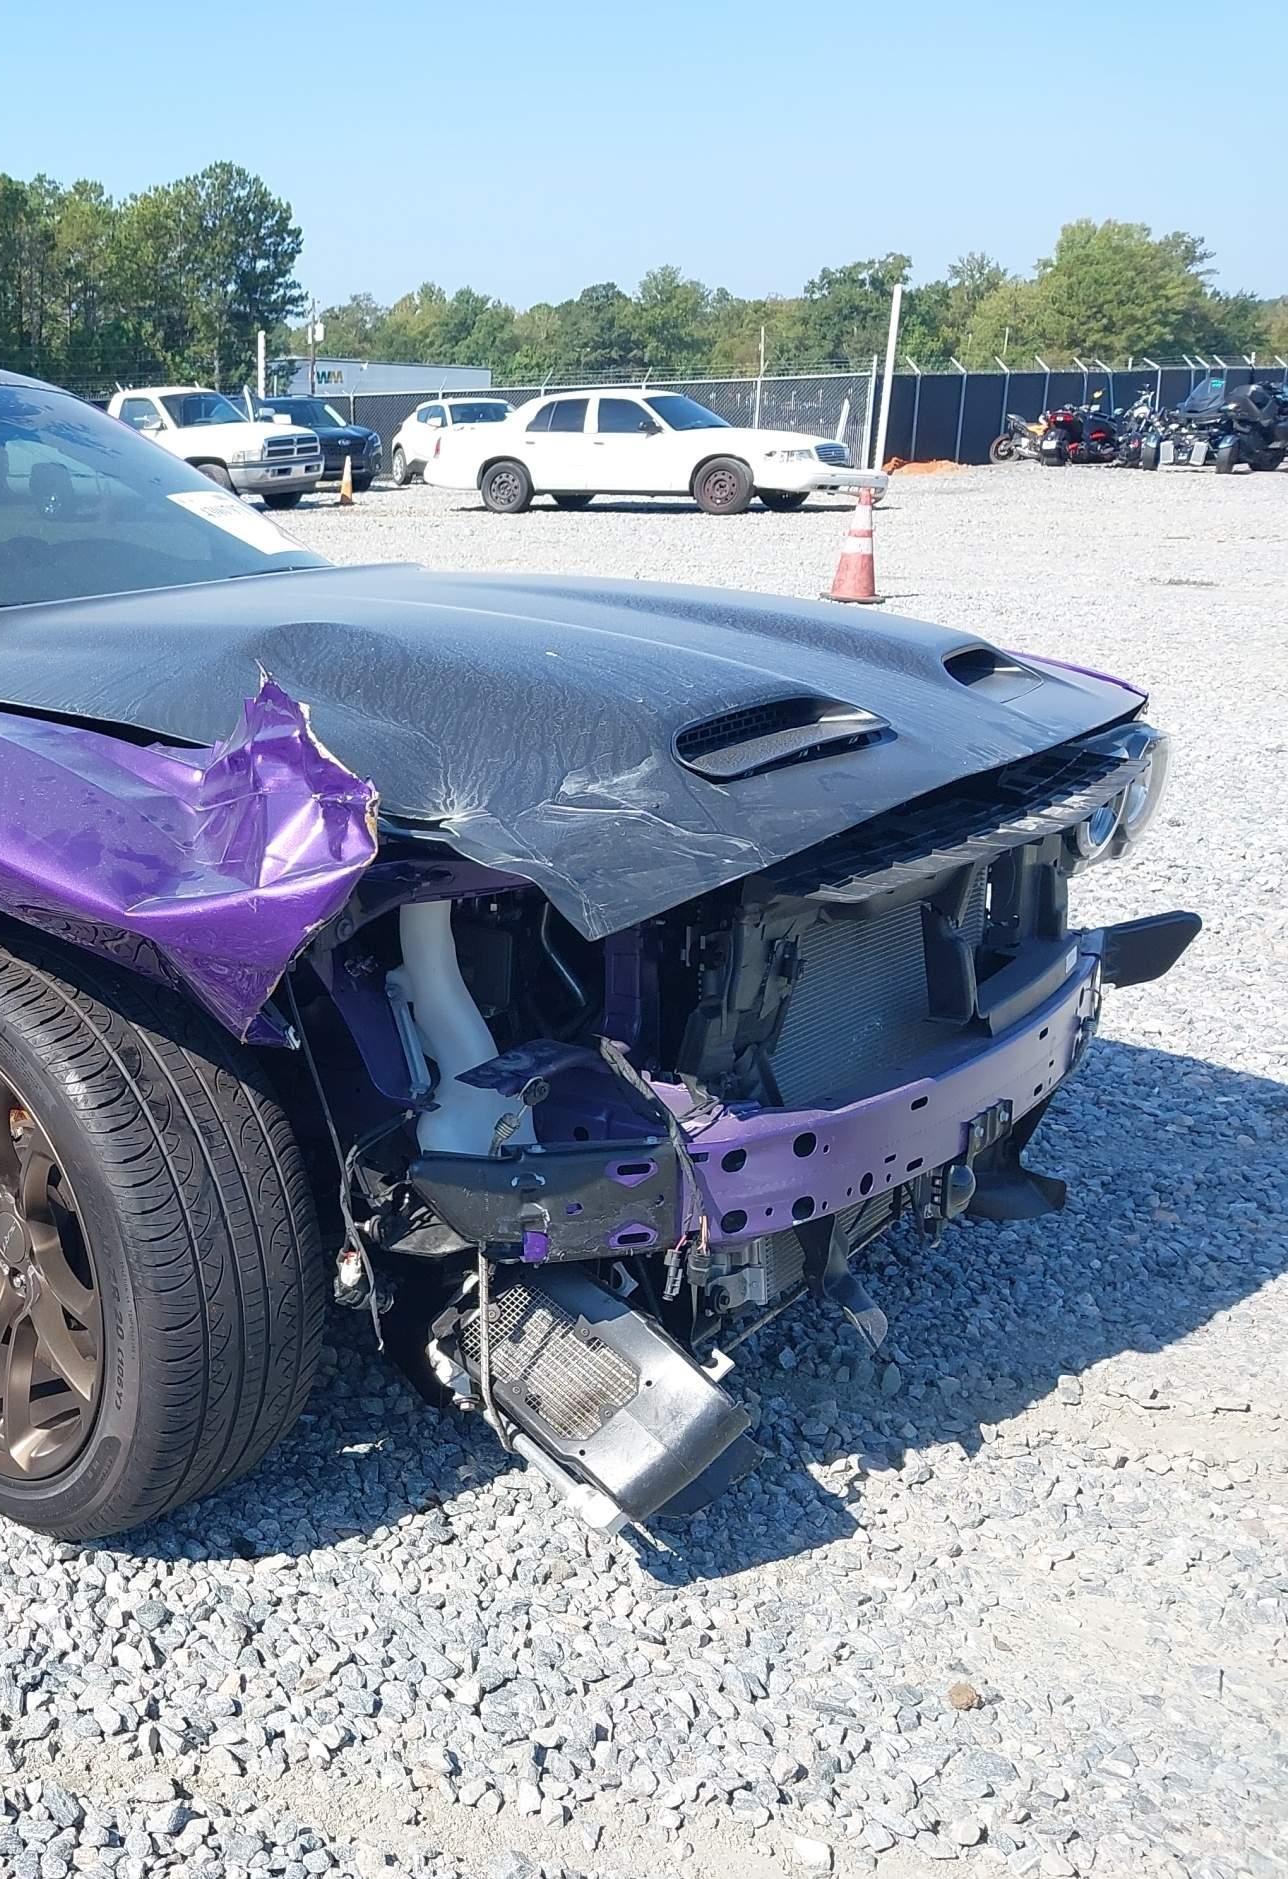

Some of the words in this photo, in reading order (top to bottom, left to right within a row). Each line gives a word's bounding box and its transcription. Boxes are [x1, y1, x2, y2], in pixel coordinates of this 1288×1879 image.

[317, 371, 343, 384] WM
[114, 1311, 125, 1341] 20
[114, 1347, 126, 1411] (106Y)
